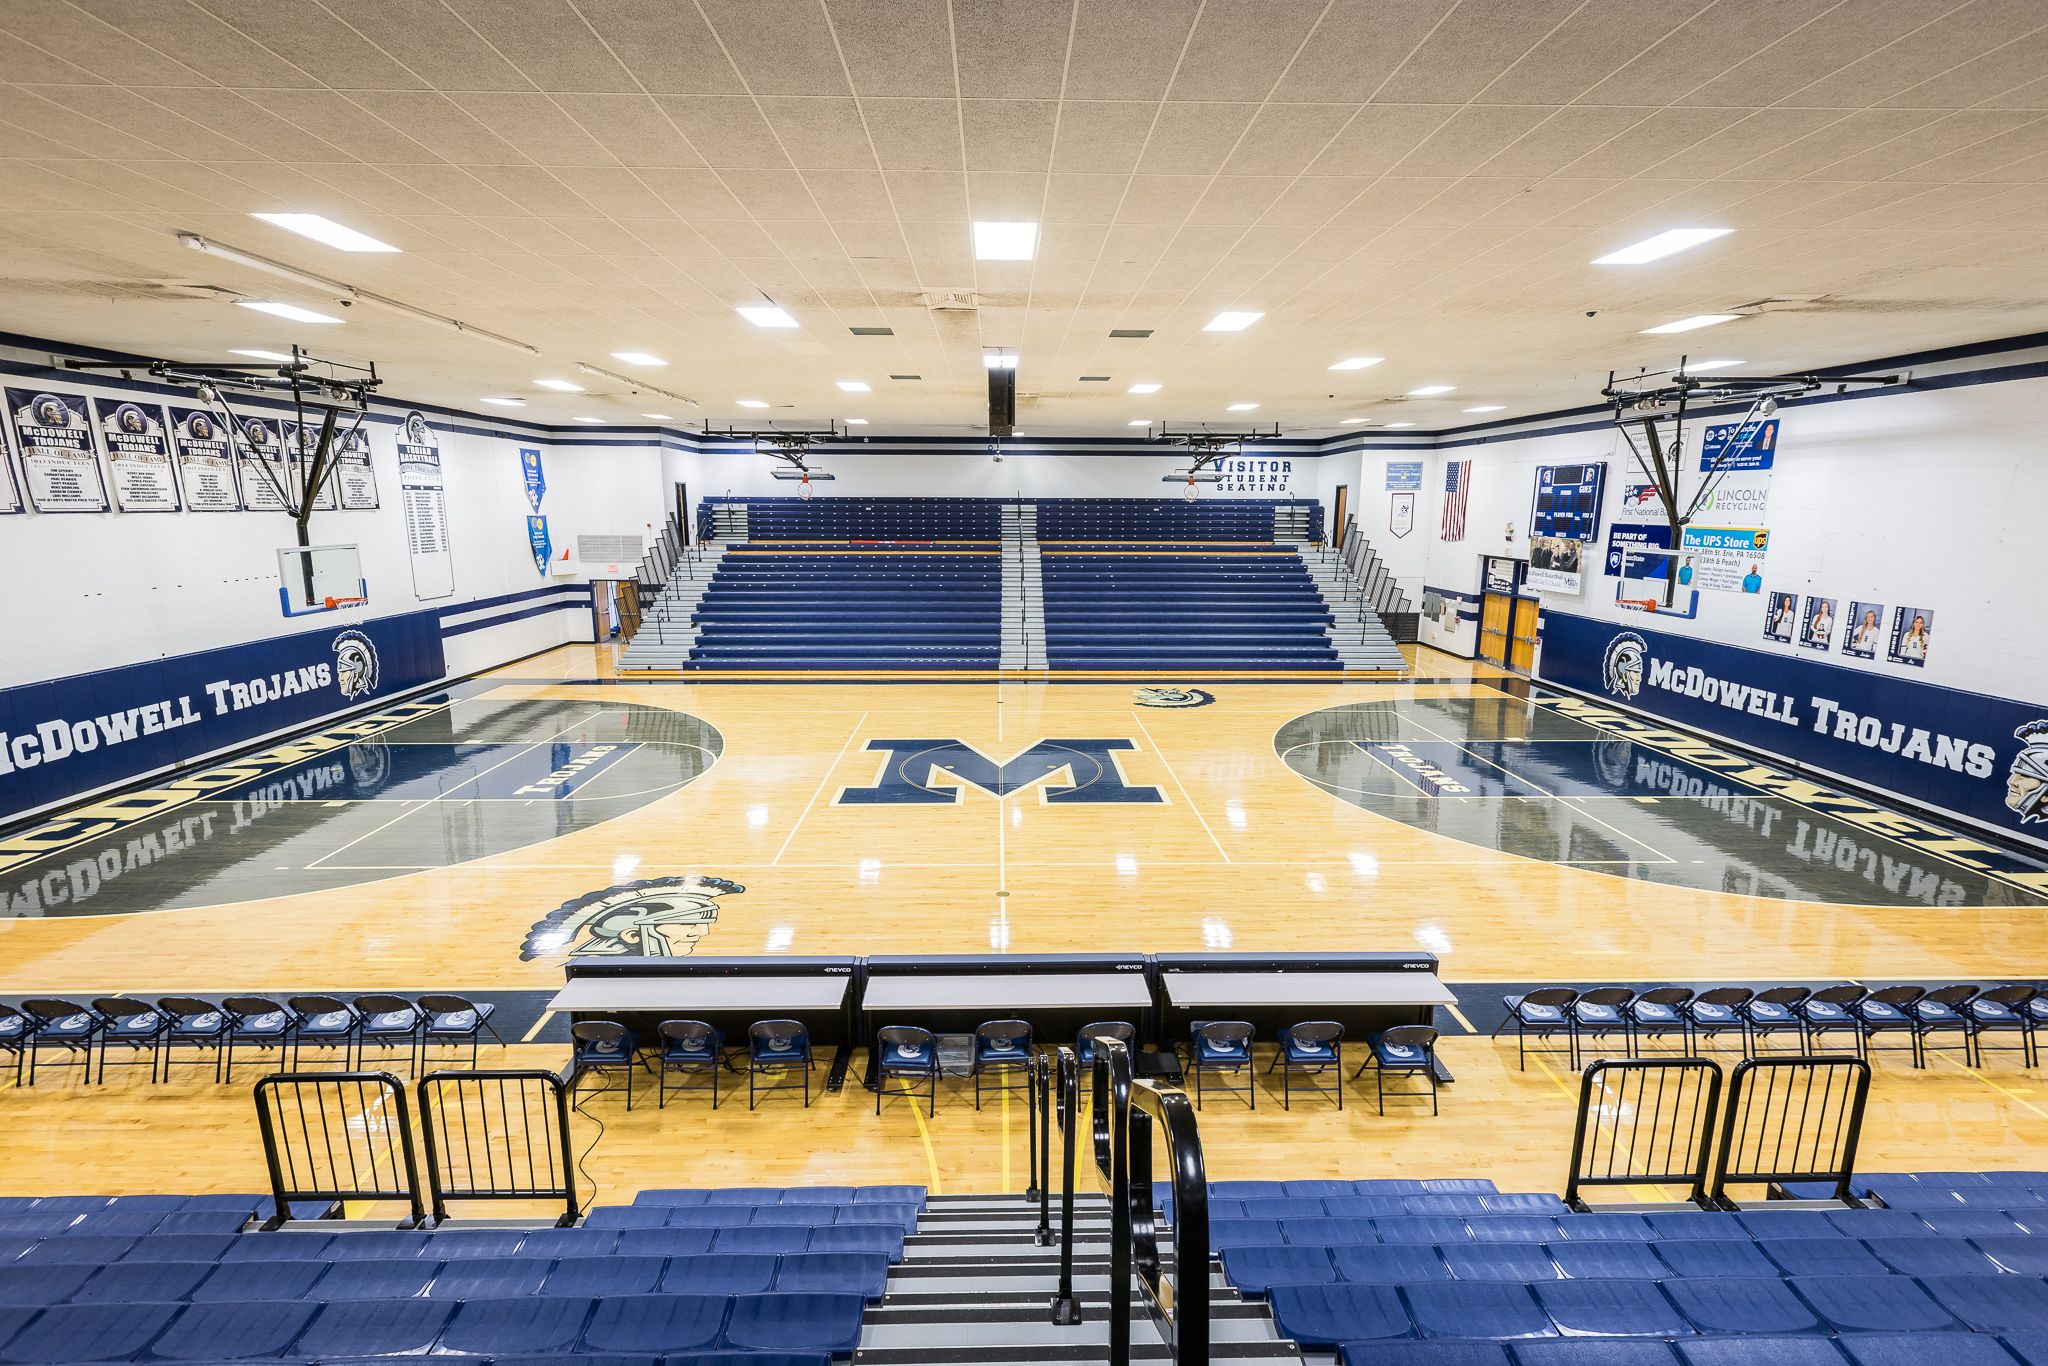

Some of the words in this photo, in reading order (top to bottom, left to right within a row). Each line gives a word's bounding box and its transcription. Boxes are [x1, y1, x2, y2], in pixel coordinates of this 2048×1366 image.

[22, 427, 84, 439] McDOWELL
[107, 433, 160, 445] McDOWELL
[33, 437, 81, 449] TROJANS
[117, 443, 157, 453] TROJANS
[180, 438, 225, 450] McDOWELL
[28, 447, 51, 455] HALL
[66, 451, 87, 459] FAME
[187, 447, 221, 458] TROJANS
[406, 446, 431, 455] TROJAN
[400, 453, 438, 465] BASKETBALL
[1214, 459, 1291, 472] VISITOR
[1541, 486, 1554, 494] HOME
[1717, 489, 1767, 501] LINCOLN
[1622, 507, 1633, 516] First
[1633, 507, 1660, 516] National
[1660, 507, 1668, 517] Ba
[1716, 503, 1764, 511] RECYCLING
[1622, 533, 1637, 541] PART
[1637, 533, 1648, 541] OF
[1685, 534, 1701, 546] The
[1702, 535, 1722, 547] UPS
[1723, 536, 1750, 549] Store
[1754, 537, 1766, 547] ups
[1612, 540, 1647, 549] SOMETHING
[1701, 548, 1713, 556] 38th
[1723, 550, 1734, 558] Erie,
[1746, 552, 1765, 560] 16508
[1700, 557, 1714, 565] (38th
[1721, 558, 1741, 567] Peach)
[1894, 607, 1902, 631] CLASS
[206, 661, 333, 716] TROJANS
[1811, 696, 1996, 779] TROJANS
[512, 745, 618, 795] TROJANS
[829, 738, 1174, 807] M
[1378, 744, 1472, 793] TROJANS
